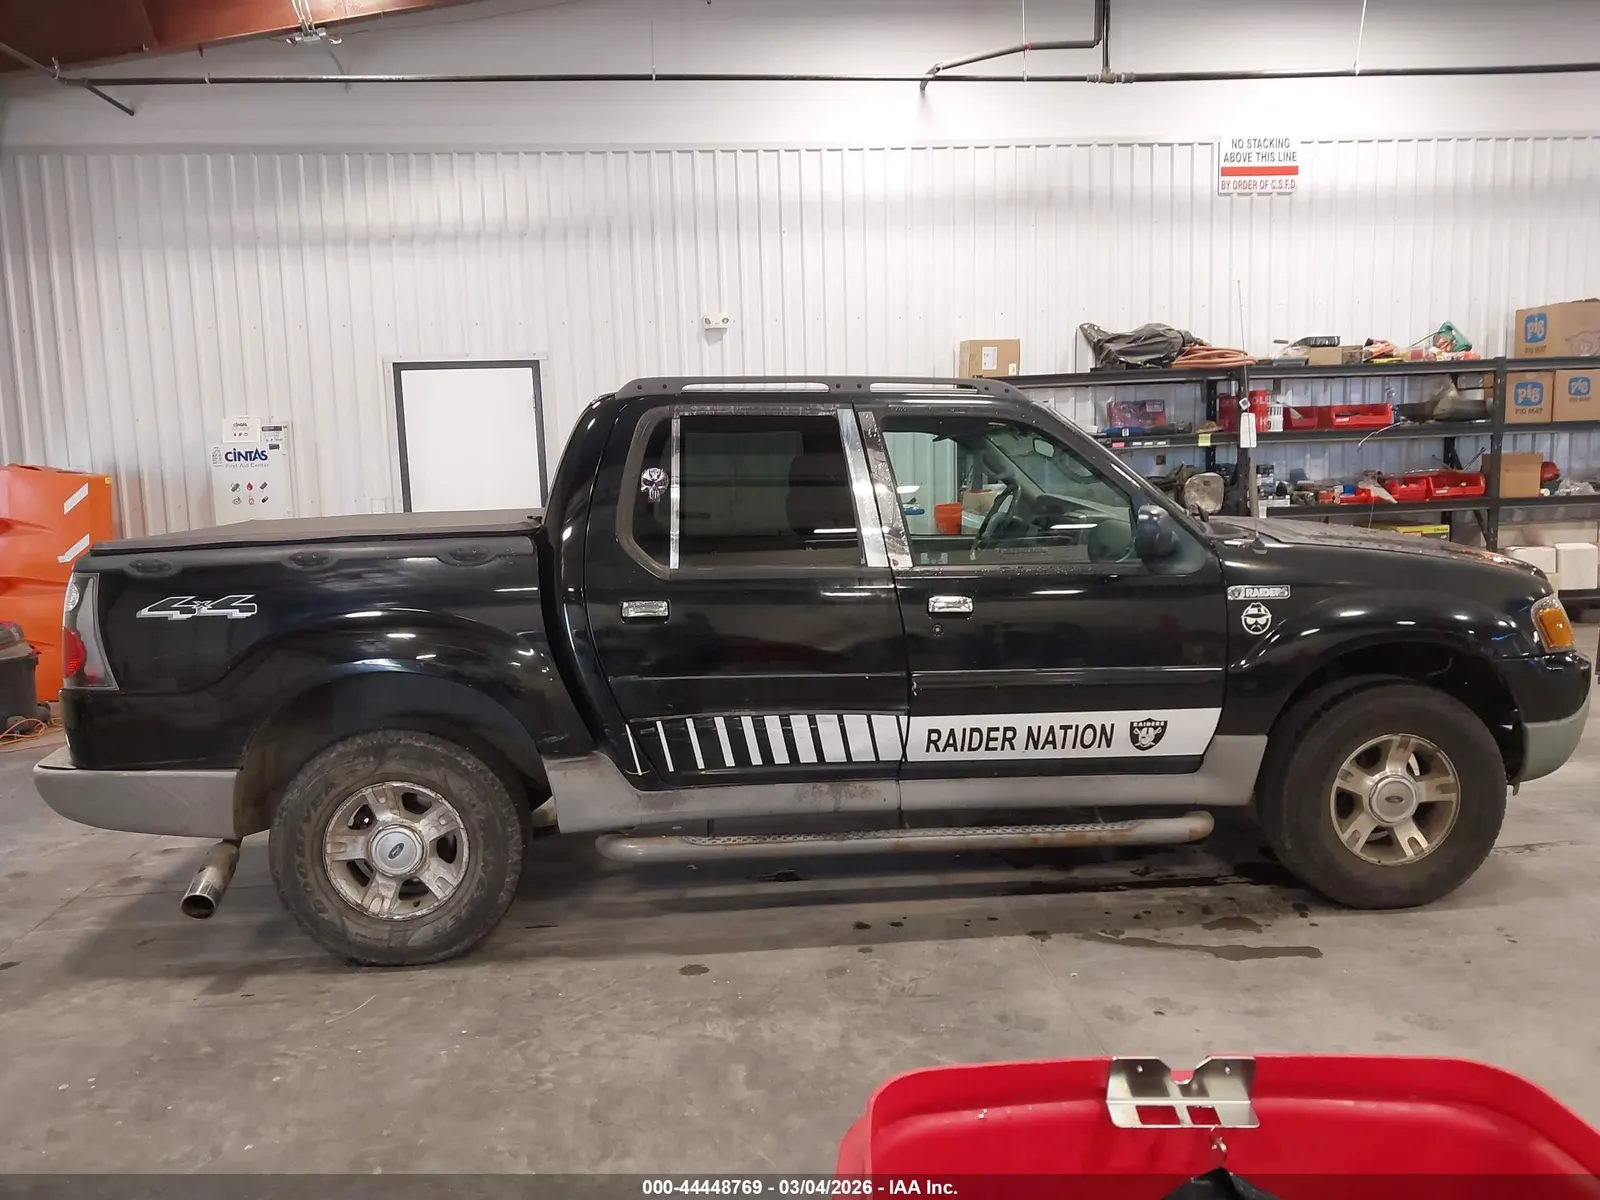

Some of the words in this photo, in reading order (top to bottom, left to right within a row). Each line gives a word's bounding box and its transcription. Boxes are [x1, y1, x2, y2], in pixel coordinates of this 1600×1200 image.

[1231, 138, 1244, 149] NO
[1246, 138, 1290, 149] STACKING
[1223, 152, 1253, 163] ABOVE
[1255, 151, 1276, 163] THIS
[1278, 151, 1298, 162] LINE
[1221, 180, 1231, 190] BY
[1232, 180, 1258, 190] ORDER
[1259, 179, 1269, 190] OF
[1517, 383, 1540, 404] pig
[1245, 588, 1288, 597] RAIDERS
[925, 726, 1018, 753] RAIDER
[1024, 723, 1115, 751] NATION
